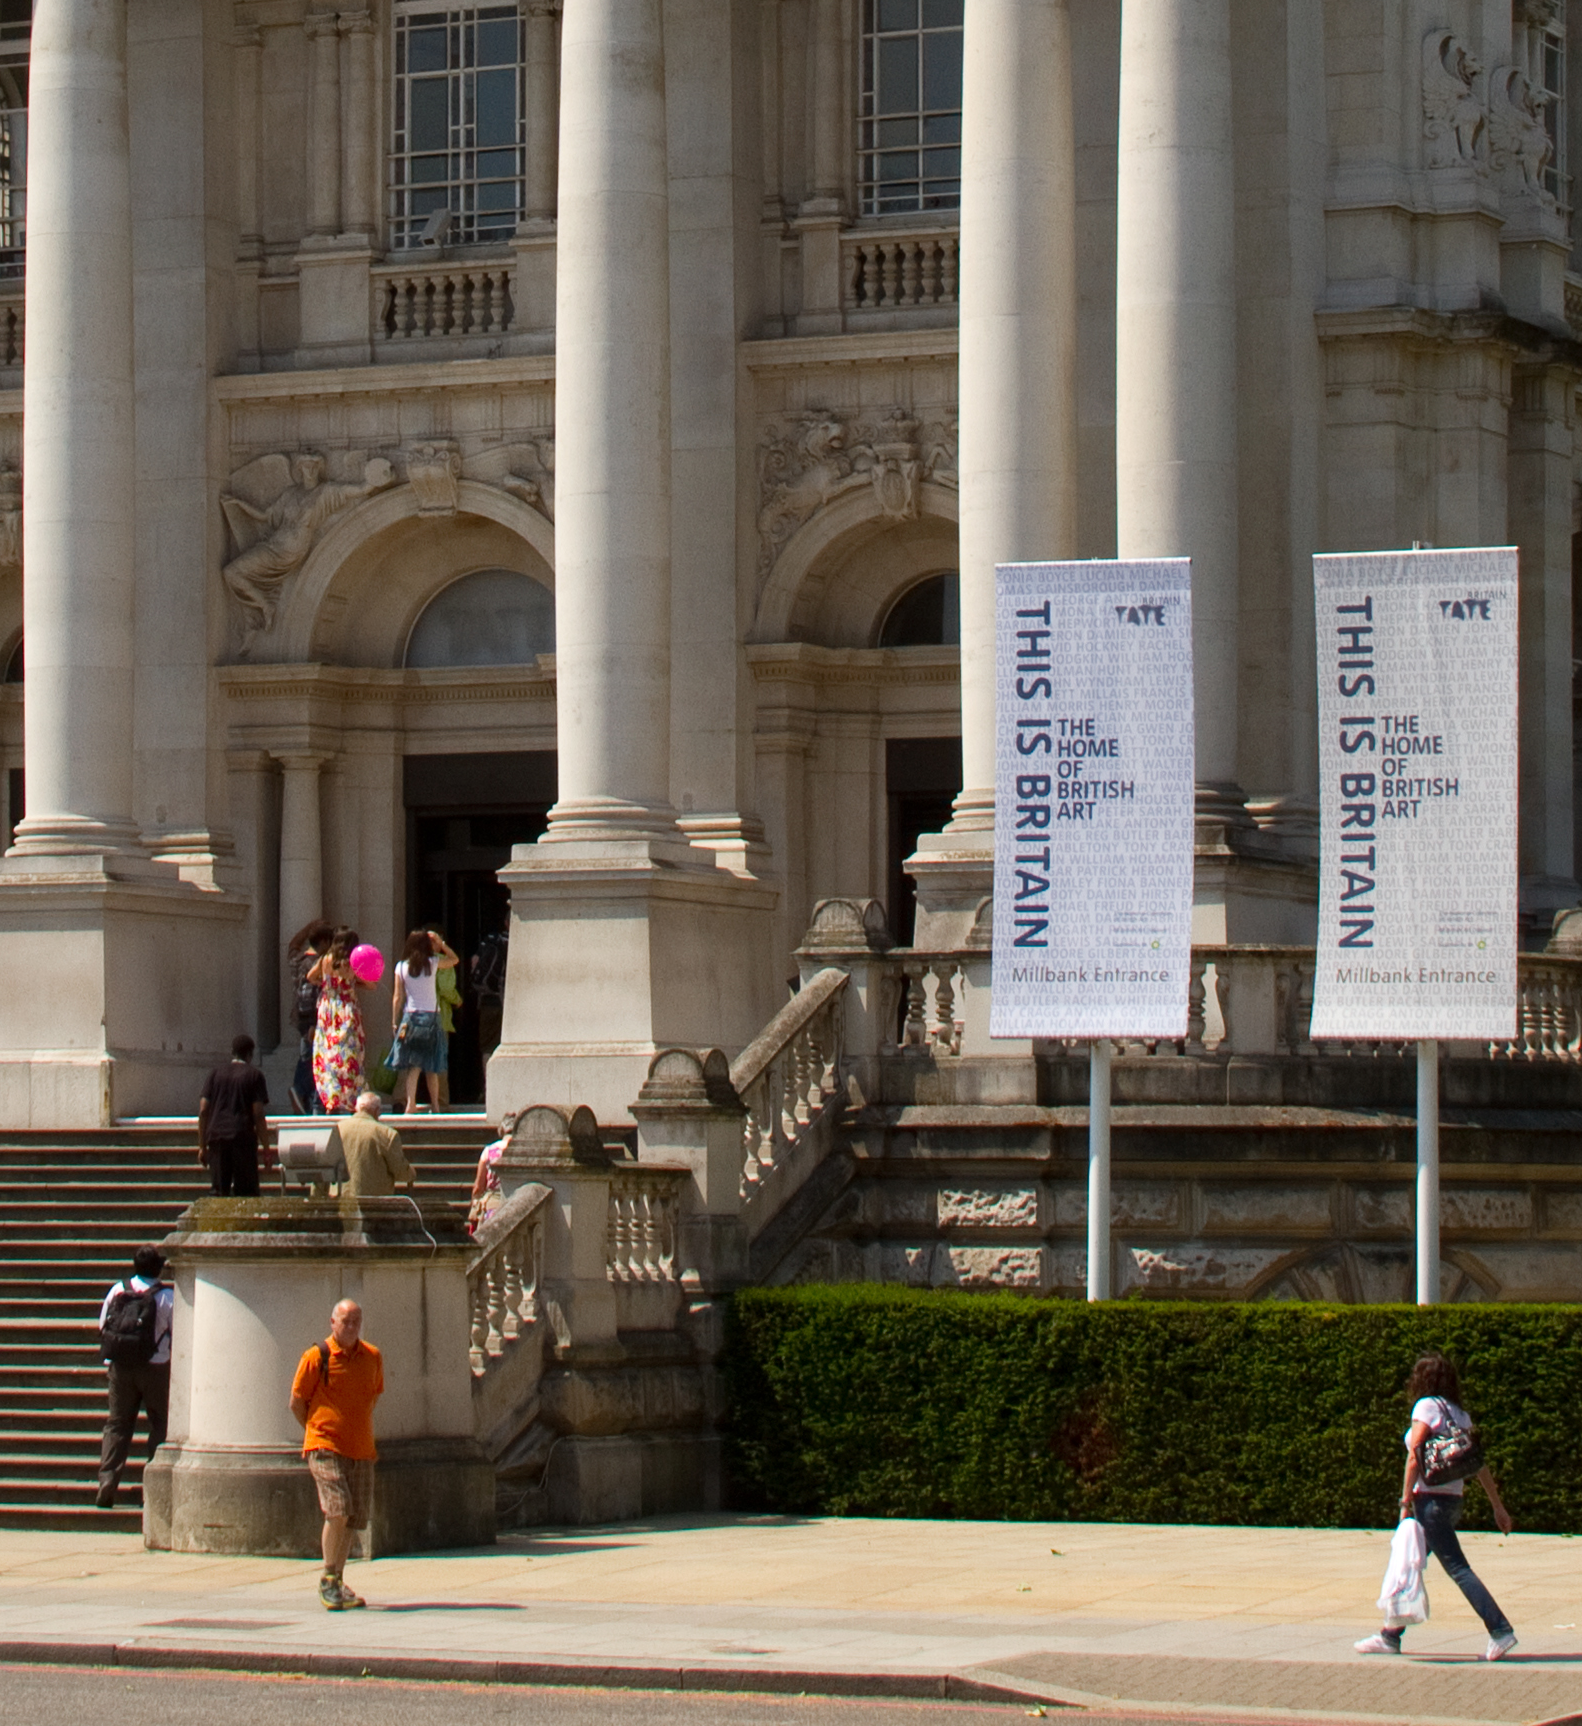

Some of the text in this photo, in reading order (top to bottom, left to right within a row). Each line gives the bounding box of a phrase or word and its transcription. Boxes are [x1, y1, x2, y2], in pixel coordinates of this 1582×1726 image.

[1142, 596, 1180, 605] BRITAIN
[1468, 591, 1506, 599] BRITAIN
[1115, 605, 1165, 625] TATE
[1439, 600, 1491, 621] TATE
[1058, 719, 1095, 736] THE
[1381, 716, 1418, 734] THE
[1058, 739, 1118, 757] HOME
[1382, 736, 1443, 755] HOME
[1015, 600, 1051, 947] THIS IS BRITAIN
[1058, 761, 1083, 778] OF
[1337, 595, 1376, 948] THIS IS BRITAIN
[1382, 758, 1407, 776] OF
[1058, 781, 1134, 799] BRITISH
[1382, 778, 1458, 797] BRITISH
[1057, 802, 1096, 820] ART
[1382, 800, 1421, 818] ART
[1012, 968, 1168, 982] Millbank Entrance
[1337, 968, 1495, 983] Millbank Entrance
